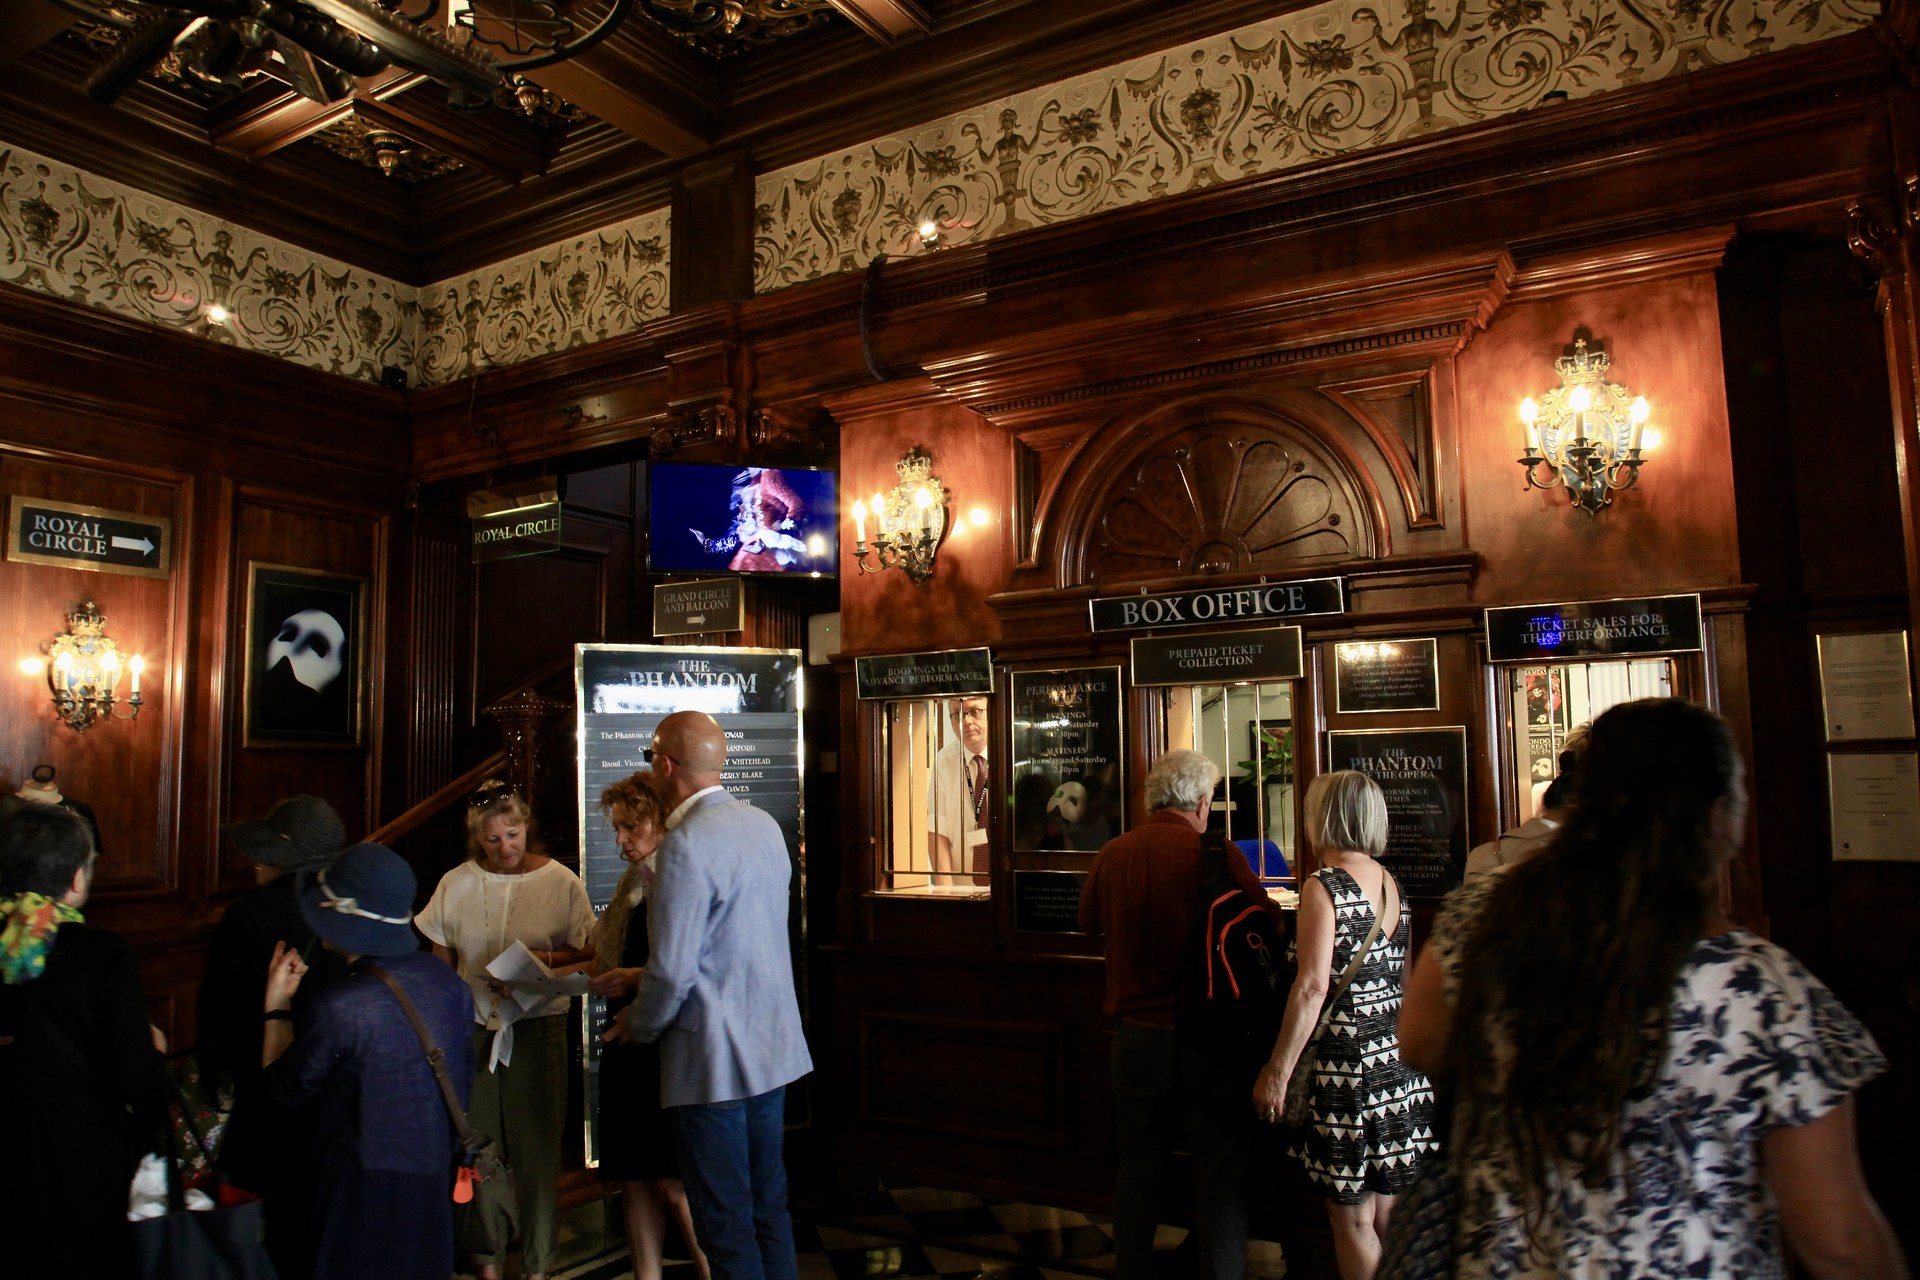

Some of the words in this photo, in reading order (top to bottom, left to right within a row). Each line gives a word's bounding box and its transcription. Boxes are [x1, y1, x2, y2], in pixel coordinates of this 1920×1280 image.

[34, 514, 104, 539] ROYAL
[474, 526, 512, 544] ROYAL
[515, 518, 558, 537] CIRCLE
[28, 531, 107, 556] CIRCLE
[663, 591, 697, 604] GRAND
[698, 587, 732, 601] CIRCLE
[664, 602, 684, 614] AND
[686, 599, 731, 612] BALCONY
[1121, 597, 1185, 626] BOX
[1192, 586, 1306, 619] OFFICE
[1526, 618, 1579, 632] TICKET
[1583, 615, 1627, 628] SALES
[1631, 613, 1663, 625] FOR
[1520, 631, 1554, 644] THIS
[1558, 624, 1670, 642] PERFORMANCE
[1168, 647, 1217, 660] PREPAID
[1220, 644, 1264, 656] TICKET
[678, 660, 711, 673] THE
[1178, 655, 1254, 669] COLLECTION
[887, 665, 936, 677] BOOKINGS
[937, 664, 957, 673] FOR
[629, 671, 758, 694] PHANTOM
[864, 676, 907, 687] ADVANCE
[909, 672, 984, 684] PERFORMANCES
[1026, 682, 1107, 696] PERFORMANCE
[1046, 711, 1087, 720] EVENINGS
[1069, 719, 1100, 729] Saturday
[723, 731, 744, 739] OWAR
[1047, 747, 1087, 756] MATINEES
[1384, 748, 1407, 757] THE
[731, 758, 771, 766] WHITEHEAD
[1060, 755, 1074, 764] and
[1075, 755, 1107, 765] Saturday
[1349, 755, 1443, 771] PHANTOM
[720, 772, 741, 780] BERLY
[741, 771, 764, 779] BLAKE
[1374, 771, 1398, 779] THE
[1398, 770, 1435, 779] OPERA
[727, 785, 750, 793] DAWES
[1384, 788, 1429, 796] ORMANCE
[1395, 824, 1424, 832] PRICES
[1408, 871, 1440, 879] TICKETS
[1414, 864, 1446, 873] DETAILS
